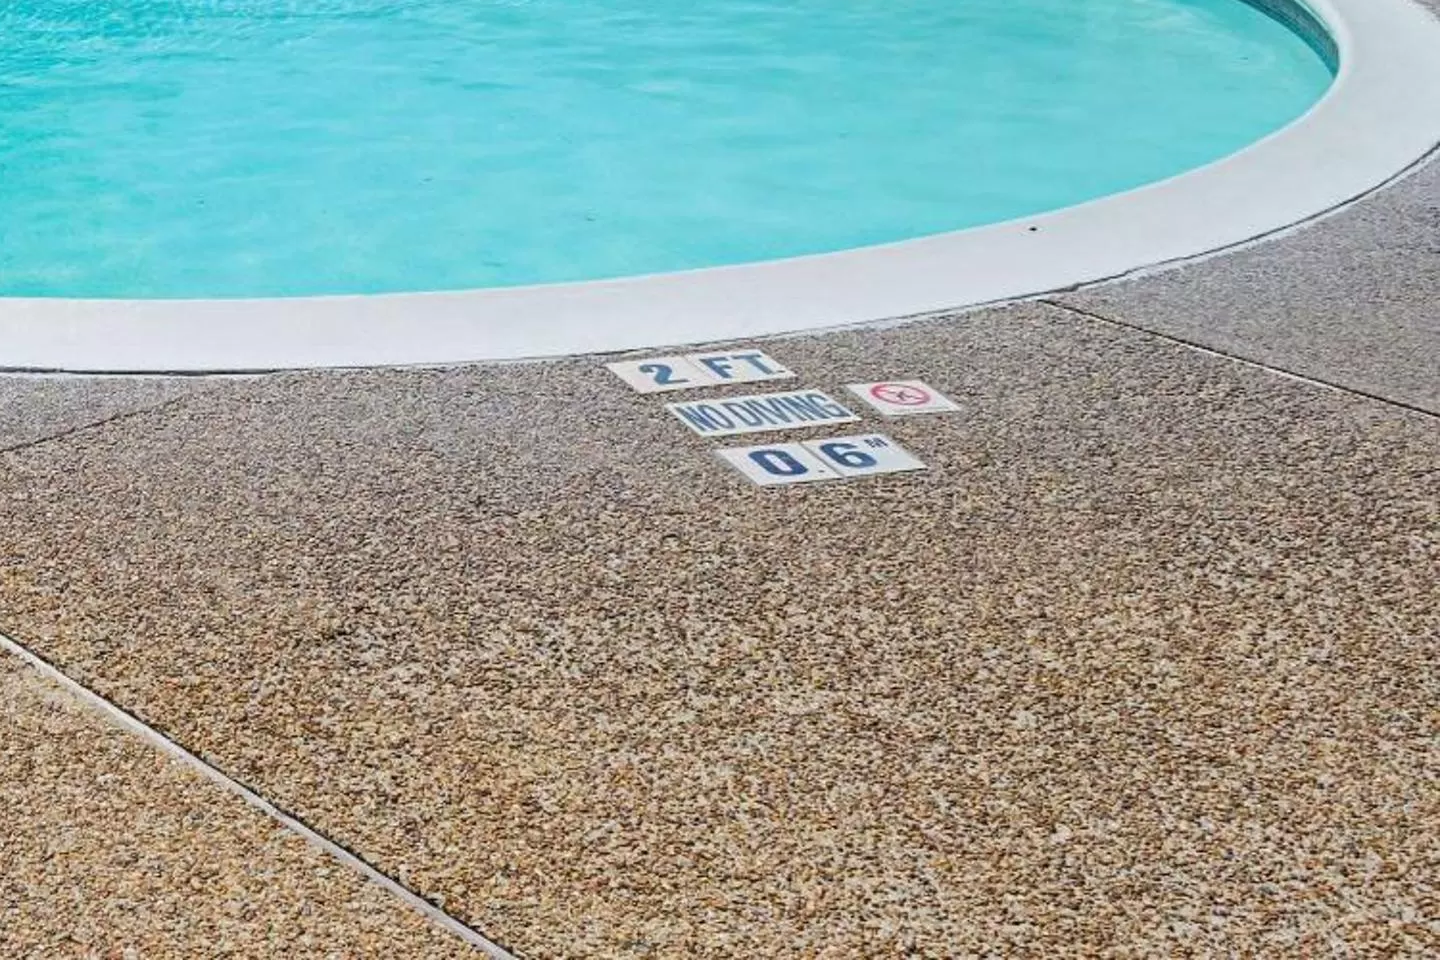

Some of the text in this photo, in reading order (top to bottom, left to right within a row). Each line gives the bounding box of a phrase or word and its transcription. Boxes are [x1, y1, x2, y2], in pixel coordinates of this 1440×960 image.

[638, 363, 690, 385] 2
[674, 392, 852, 431] NO DIVING
